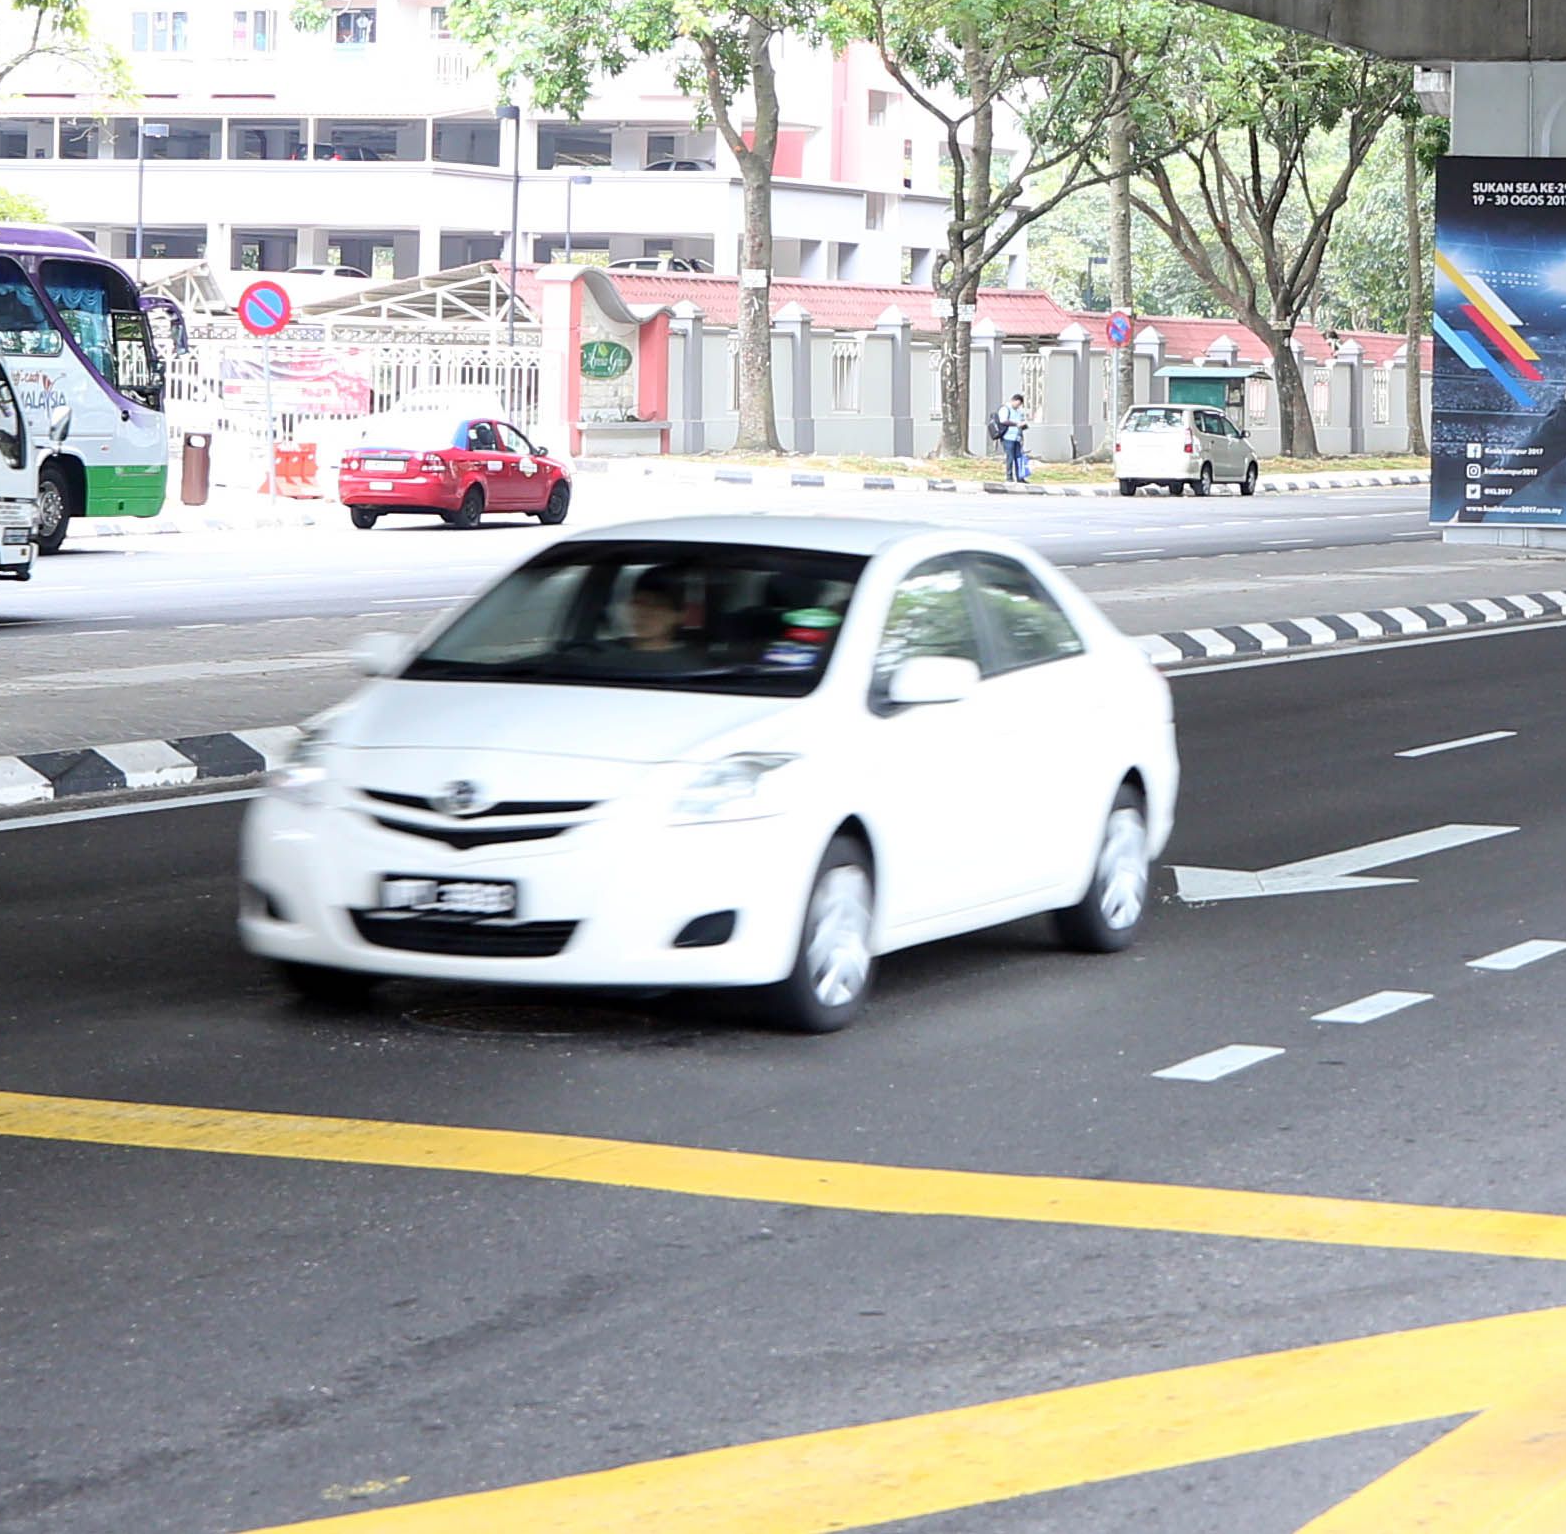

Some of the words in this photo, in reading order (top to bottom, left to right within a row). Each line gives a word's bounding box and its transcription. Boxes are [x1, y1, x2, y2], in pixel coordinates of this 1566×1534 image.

[1472, 182, 1513, 194] SUKAN
[1515, 182, 1538, 194] SEA
[1472, 195, 1484, 206] 19
[1495, 195, 1509, 206] 30
[1510, 195, 1545, 206] OGOS
